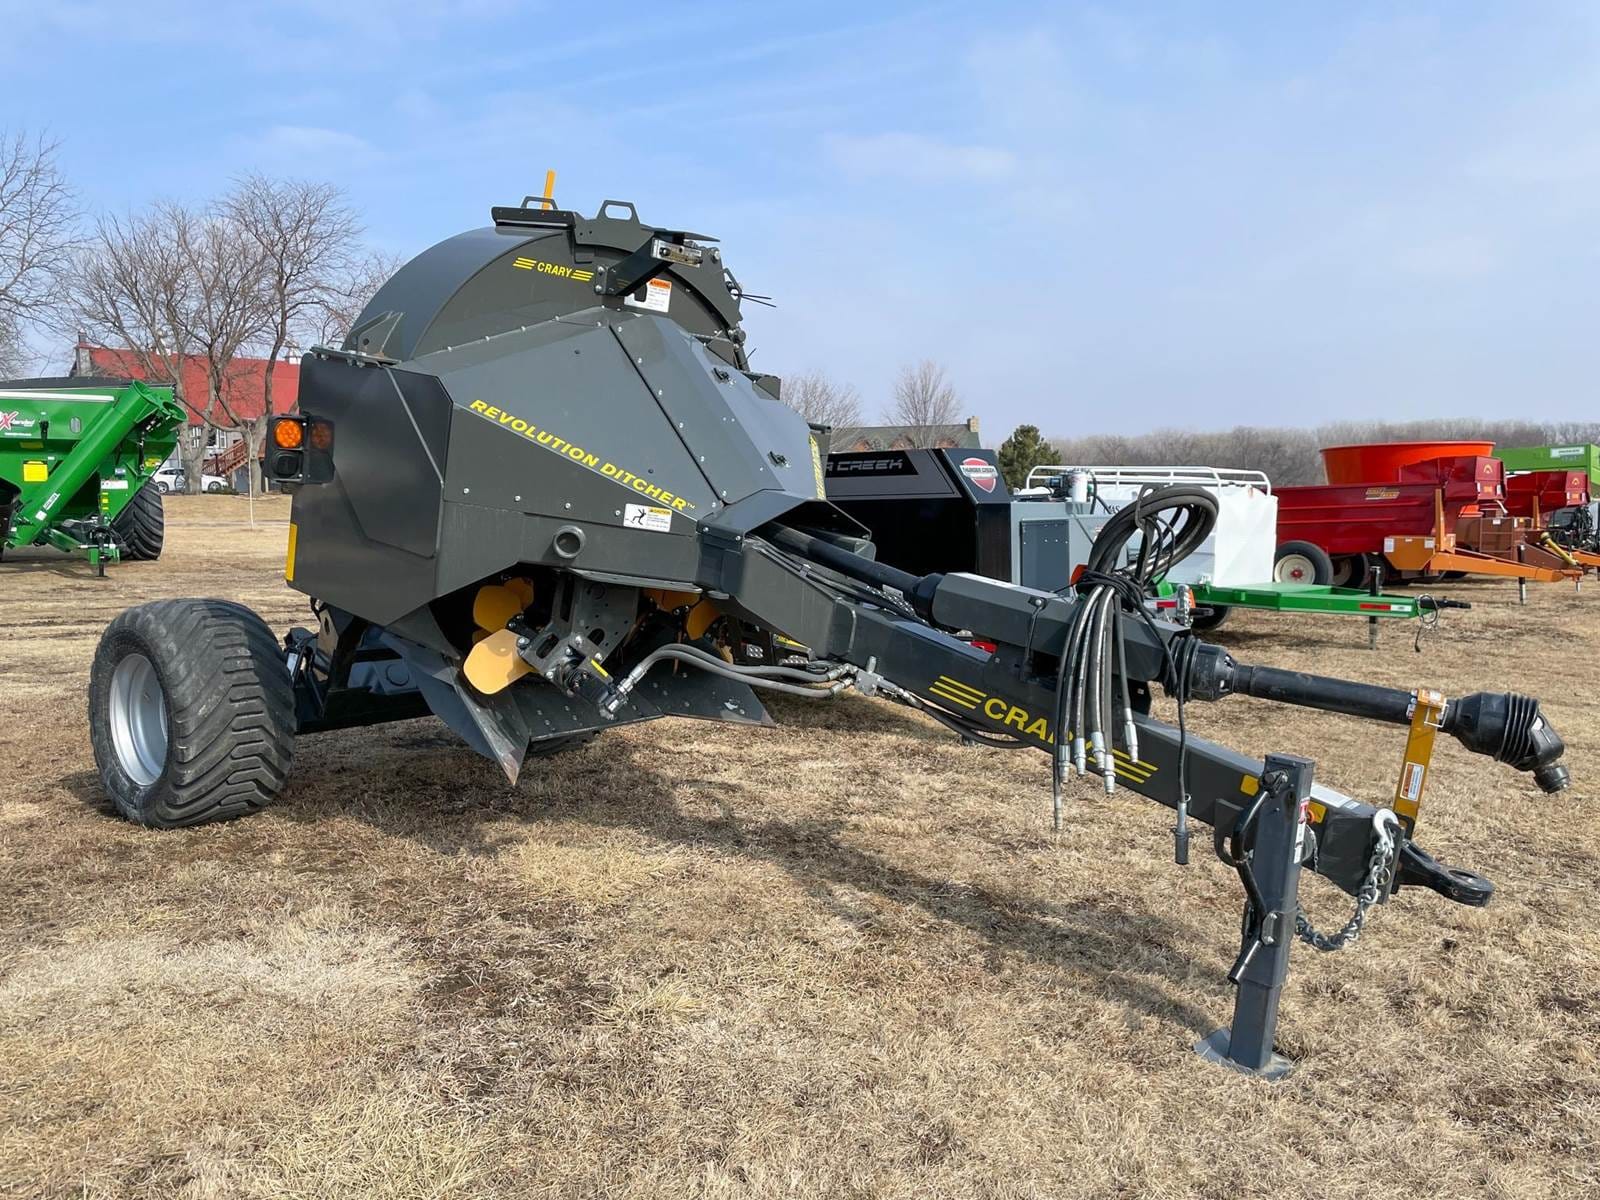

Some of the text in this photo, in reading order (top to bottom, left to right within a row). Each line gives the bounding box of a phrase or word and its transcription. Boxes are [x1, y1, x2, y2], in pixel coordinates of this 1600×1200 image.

[537, 262, 572, 278] CRARY
[469, 399, 600, 467] REVOLUTION
[600, 462, 687, 511] DITCHER
[837, 459, 903, 471] CREEK
[984, 698, 1093, 752] CRA
